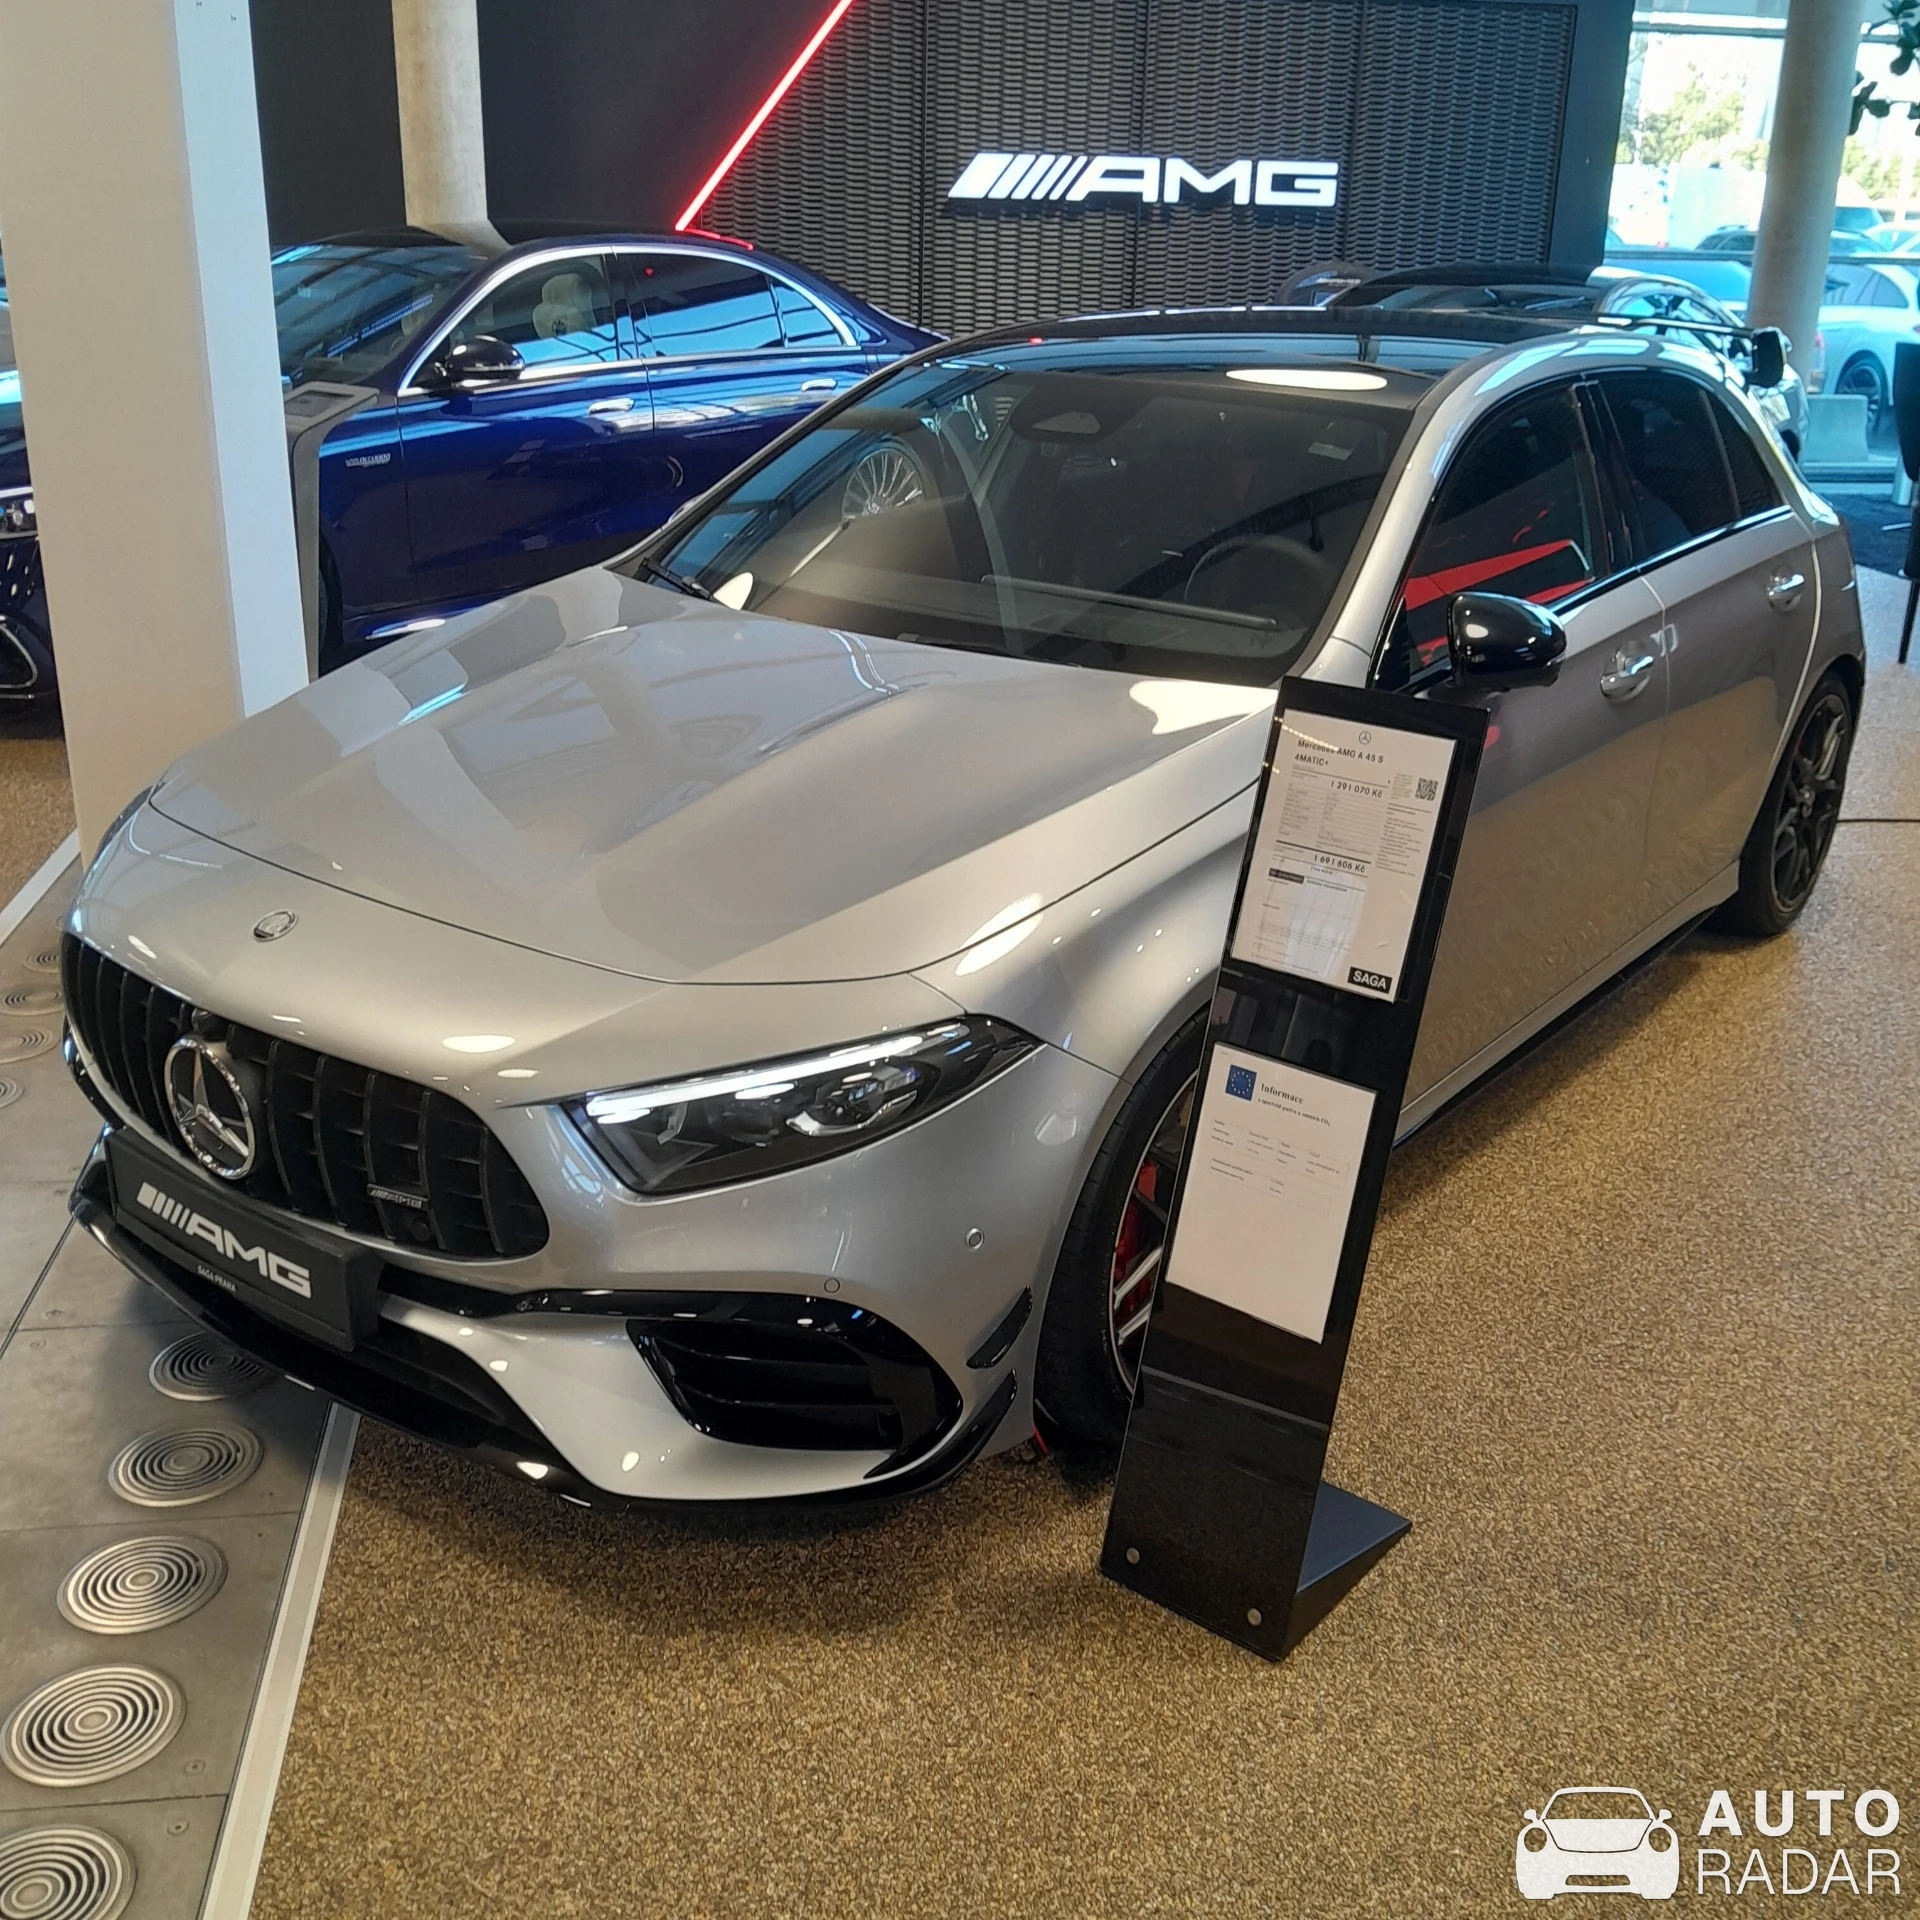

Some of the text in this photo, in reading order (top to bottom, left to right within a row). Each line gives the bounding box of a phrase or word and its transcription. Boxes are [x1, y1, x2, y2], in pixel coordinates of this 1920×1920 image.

[1065, 155, 1339, 207] AMG
[1294, 753, 1329, 767] 4MATIC+
[1357, 752, 1363, 760] A
[1365, 752, 1376, 763] 45
[1378, 755, 1384, 764] S
[1354, 784, 1370, 796] 070
[1320, 854, 1335, 866] 691
[1337, 857, 1353, 870] 606
[1352, 969, 1387, 990] SAGA
[1260, 1083, 1304, 1105] Informace
[185, 1212, 311, 1299] AMG
